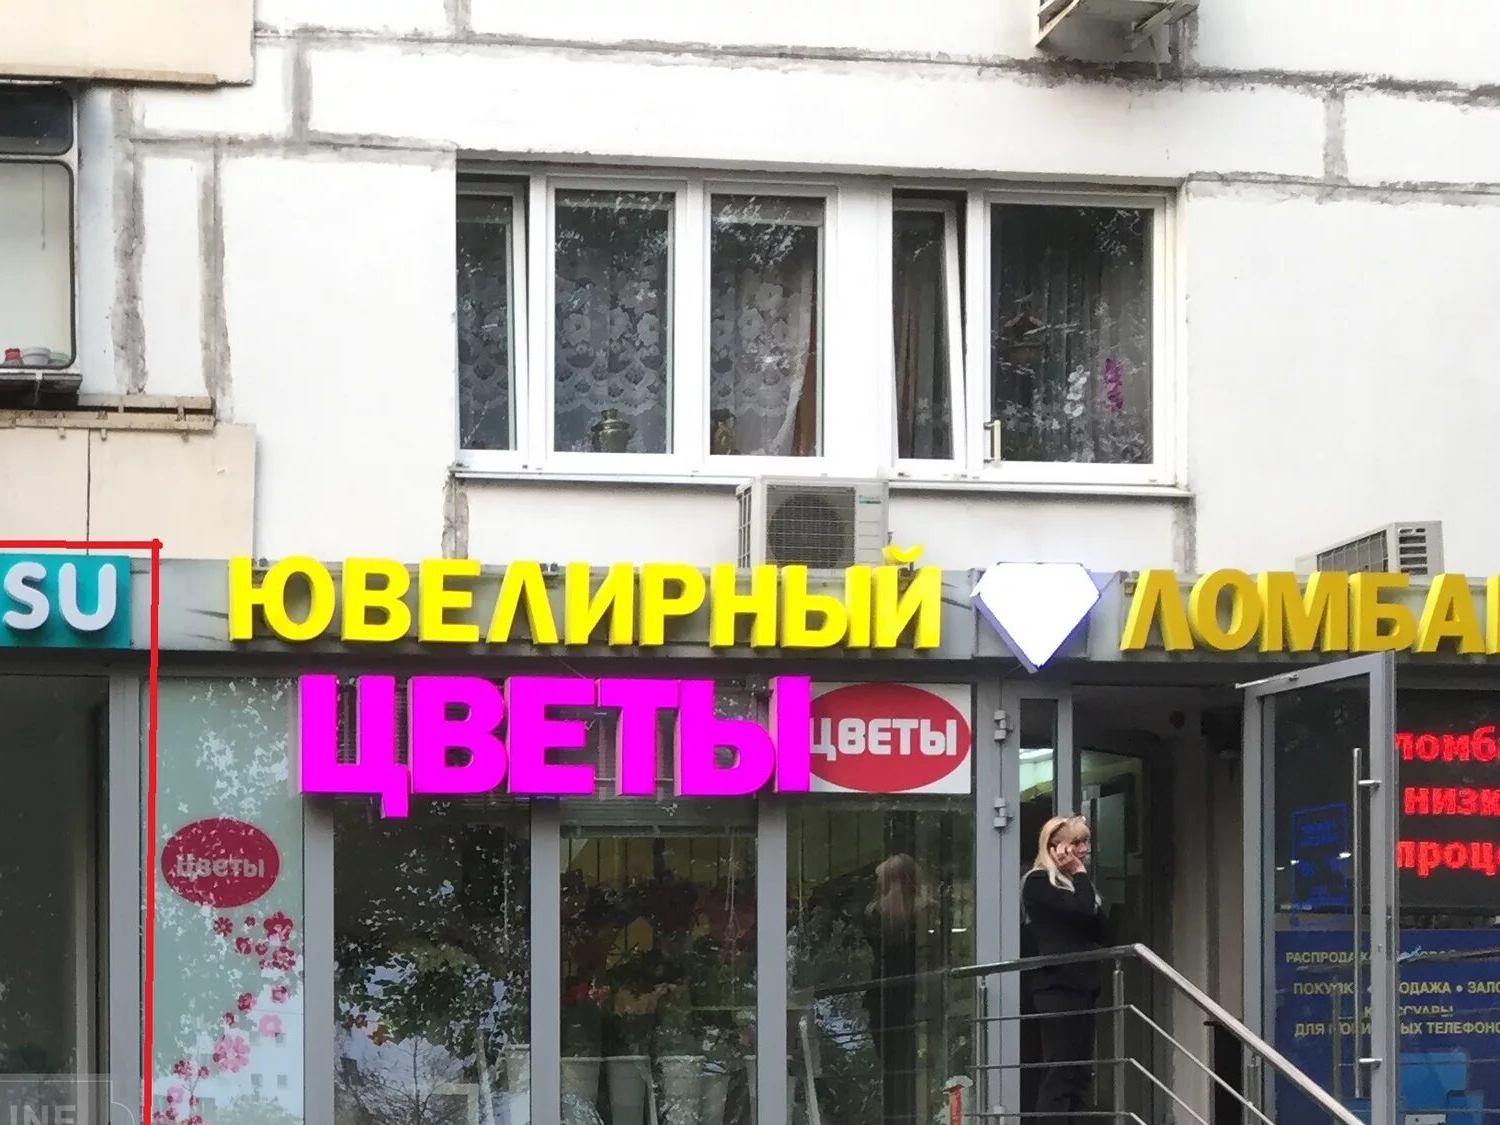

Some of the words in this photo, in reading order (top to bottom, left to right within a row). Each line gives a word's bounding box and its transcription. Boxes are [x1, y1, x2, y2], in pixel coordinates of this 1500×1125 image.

[228, 544, 941, 650] ЮВЕЛИРНЫЙ
[299, 674, 811, 819] ЦВЕТЫ
[810, 717, 958, 761] ЦВЕТЫ
[1394, 726, 1500, 762] ломб
[1395, 840, 1500, 876] проц
